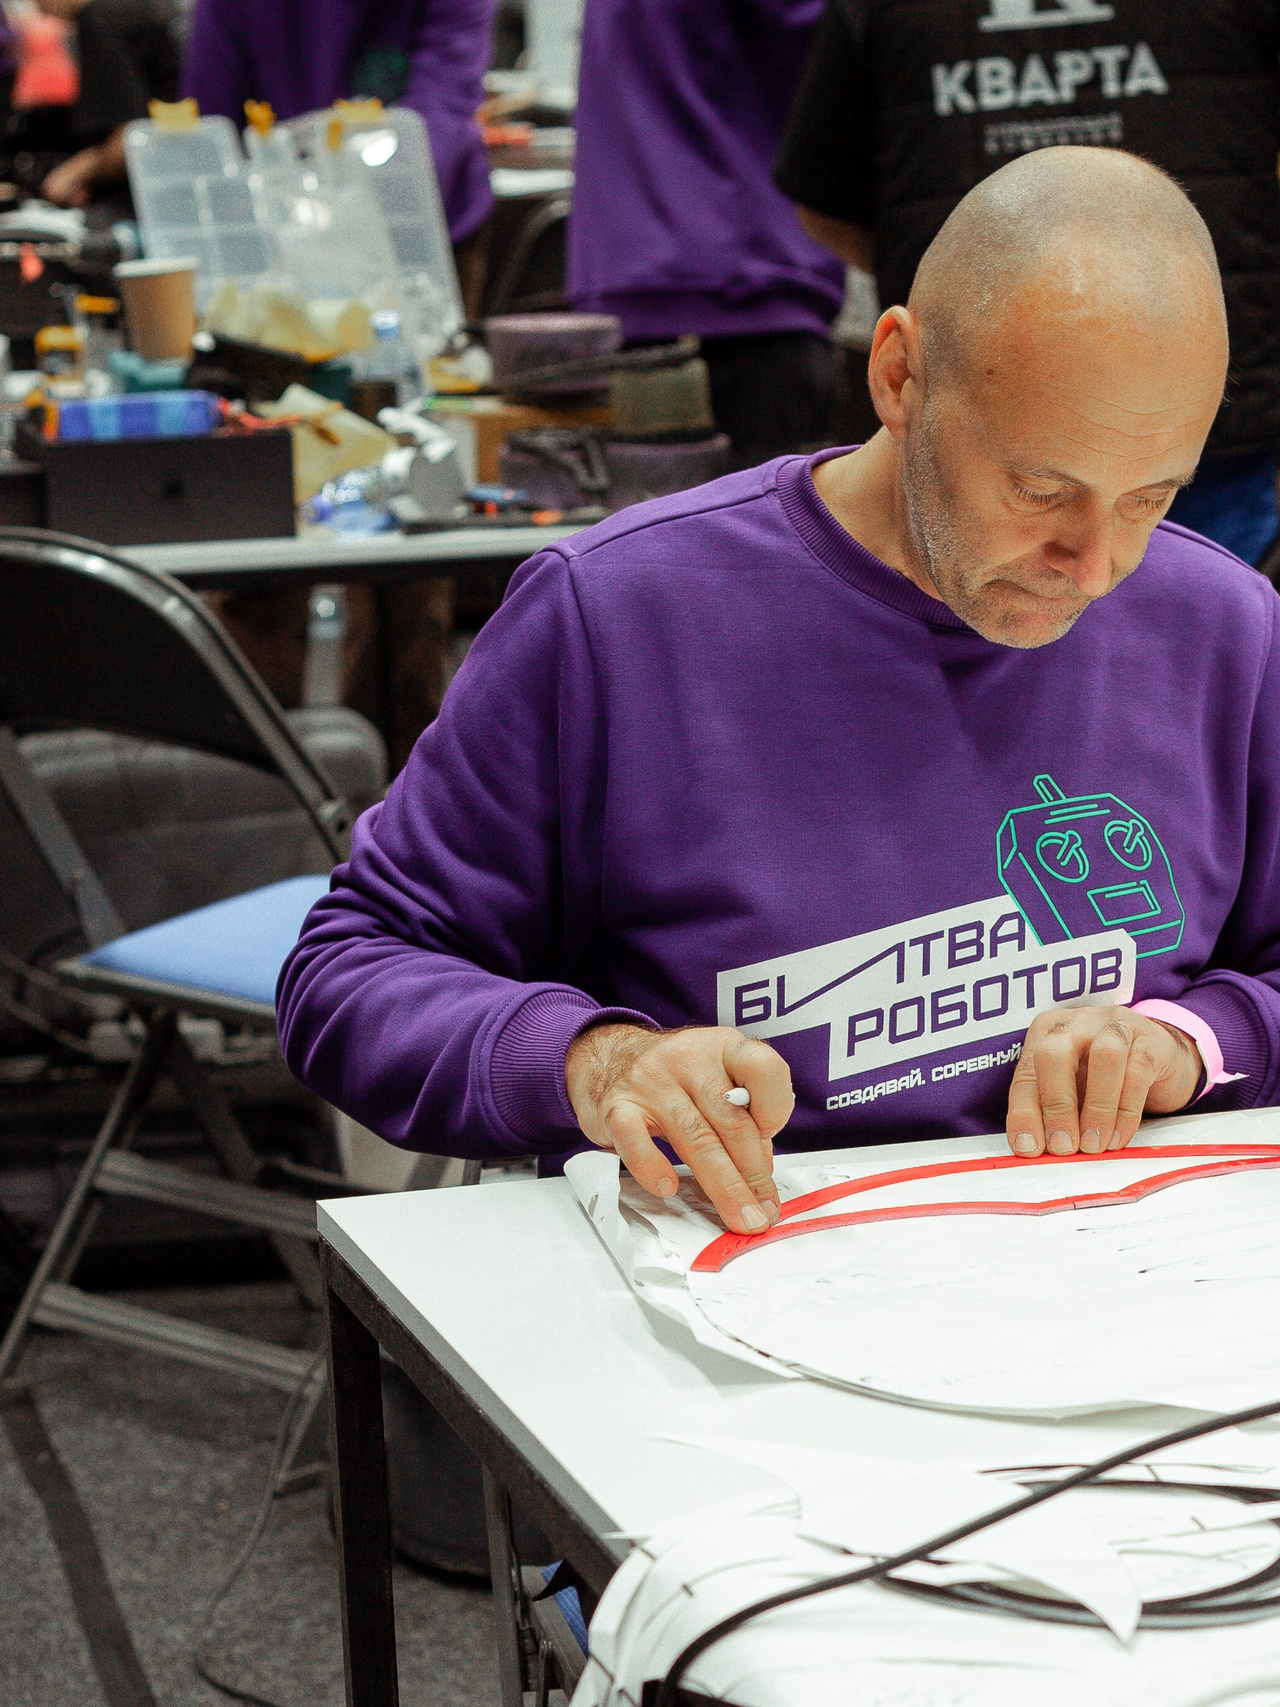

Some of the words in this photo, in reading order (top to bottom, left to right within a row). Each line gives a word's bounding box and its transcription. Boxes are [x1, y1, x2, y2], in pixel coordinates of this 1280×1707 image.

[931, 42, 1169, 116] КВАРТА
[734, 910, 1027, 1028] БИТВА
[845, 947, 1123, 1058] РОБОТОВ
[826, 1068, 926, 1111] СОЗДАВАЙ.
[931, 1042, 1024, 1083] СОРЕВНУЙ
